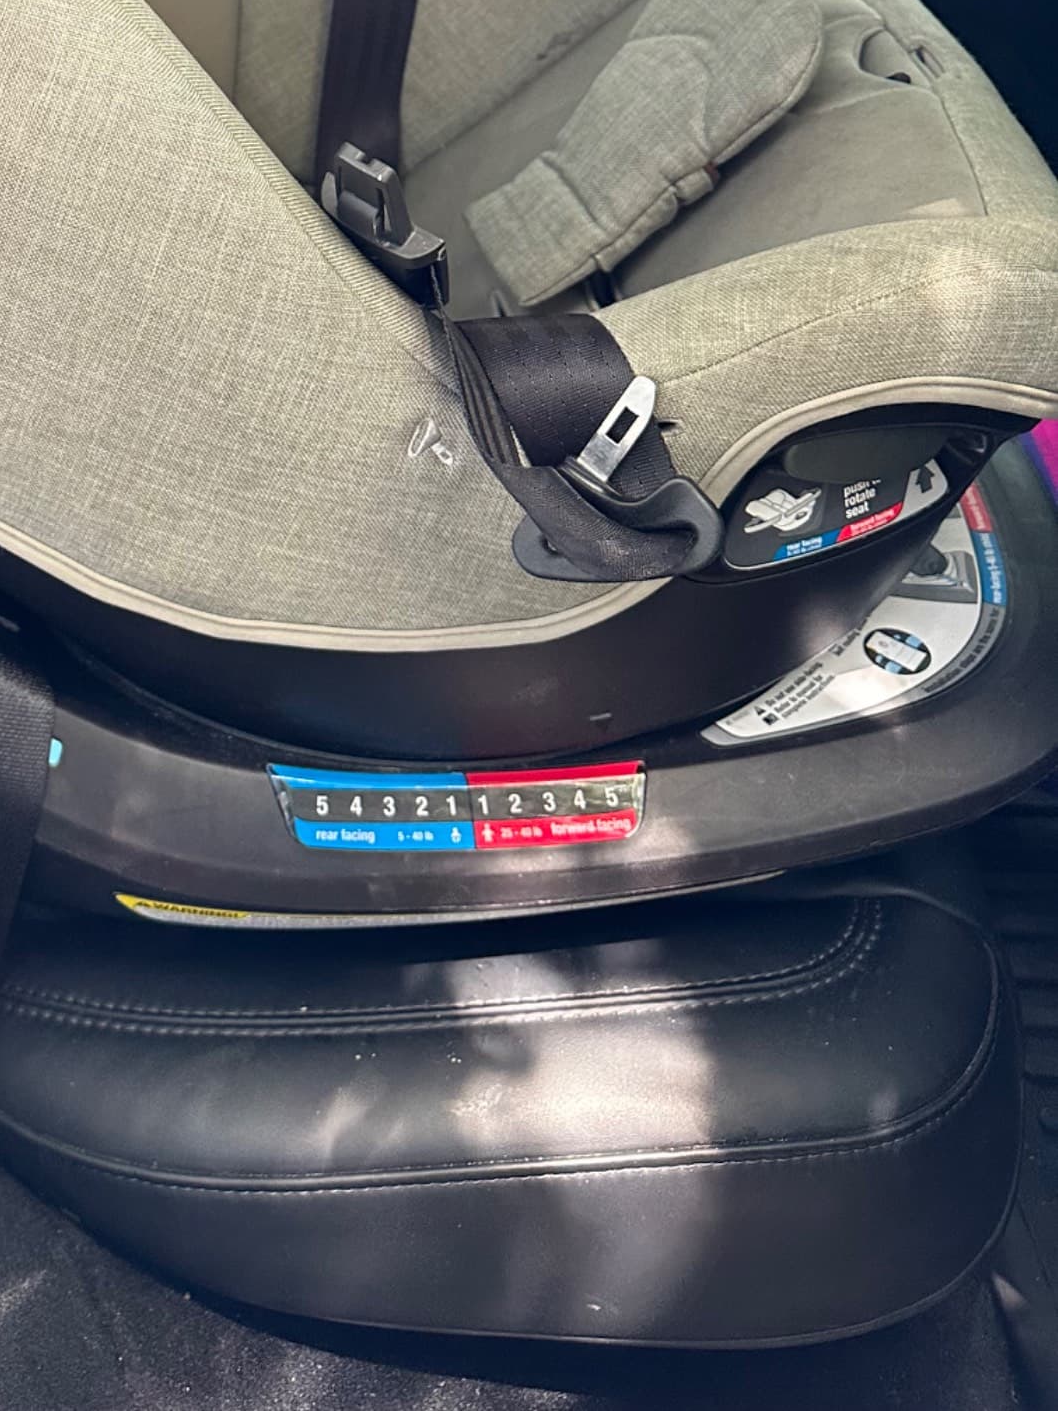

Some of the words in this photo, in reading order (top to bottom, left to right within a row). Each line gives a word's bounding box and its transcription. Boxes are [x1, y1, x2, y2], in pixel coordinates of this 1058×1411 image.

[844, 488, 876, 507] rotate
[845, 501, 870, 519] seat
[316, 795, 328, 816] 5
[350, 796, 362, 817] 4
[383, 795, 395, 816] 3
[416, 795, 429, 816] 2
[446, 795, 457, 816] 1
[478, 796, 489, 815] 1
[509, 793, 522, 813] 2
[542, 792, 556, 811] 3
[574, 789, 586, 809] 4
[606, 787, 619, 807] 5
[315, 829, 339, 840] rear
[341, 828, 376, 844] facing
